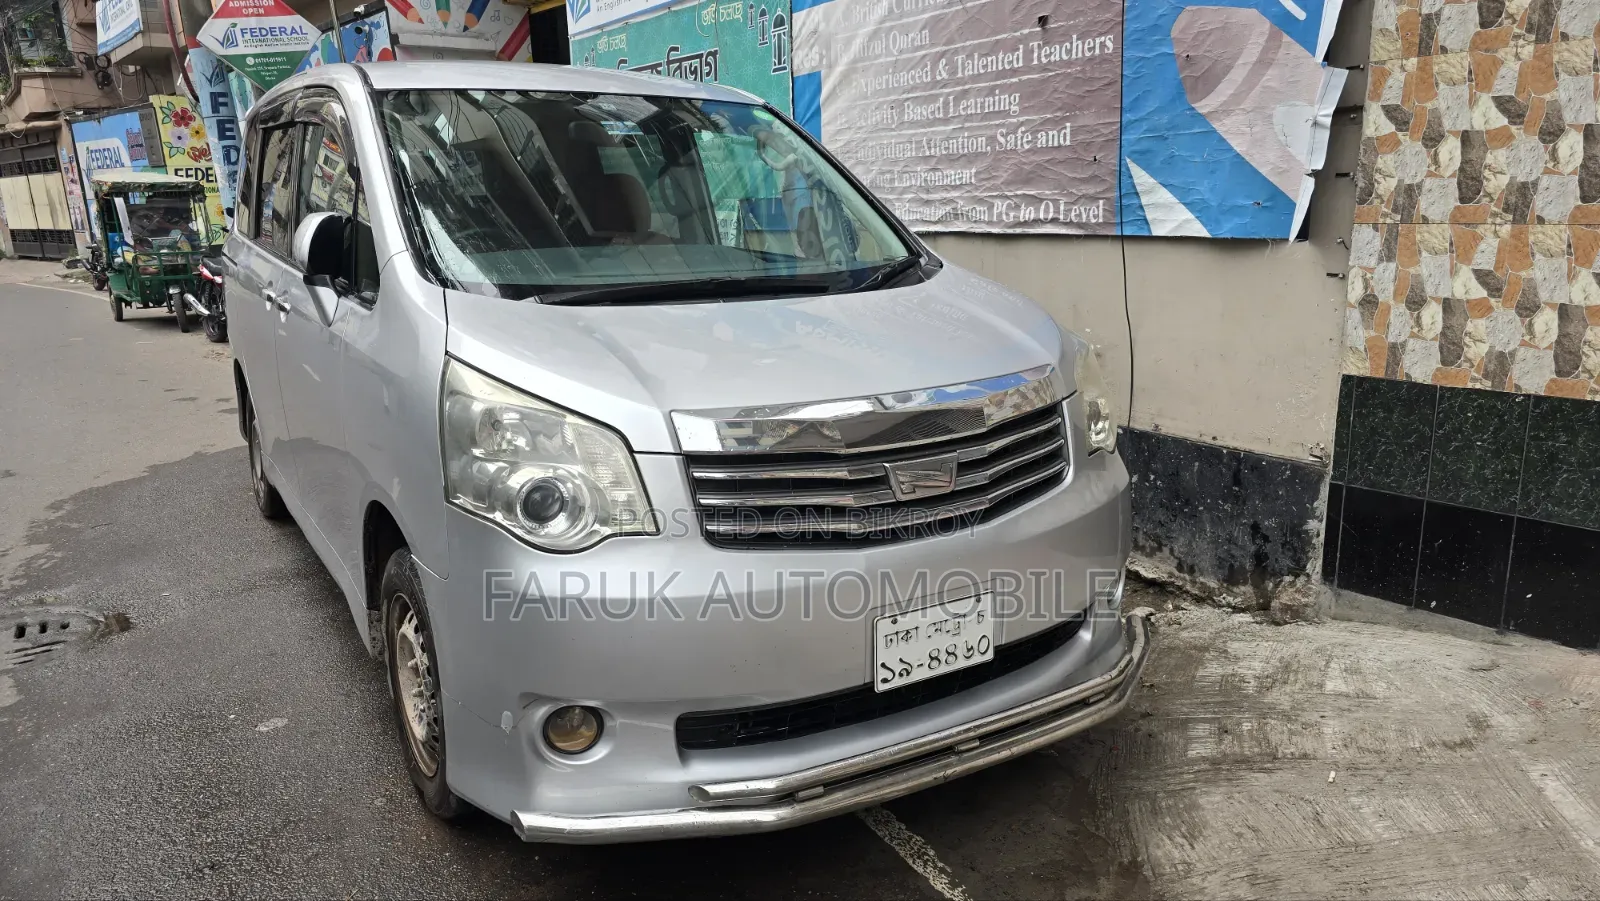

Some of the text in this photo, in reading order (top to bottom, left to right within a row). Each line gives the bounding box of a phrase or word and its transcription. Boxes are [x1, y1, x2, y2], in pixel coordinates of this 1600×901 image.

[242, 7, 265, 15] OPEN
[240, 25, 309, 38] FEDERAL
[242, 35, 309, 45] INTERNATIONAL SCHOOL
[889, 28, 930, 55] Quran
[936, 58, 950, 81] &
[954, 44, 1024, 80] Talented
[1029, 34, 1115, 66] Teachers
[903, 97, 943, 122] Based
[947, 90, 1021, 118] Learning
[919, 132, 991, 157] Attention,
[995, 126, 1032, 151] Safe
[1037, 123, 1071, 147] and
[90, 146, 126, 169] FEDERAL
[893, 165, 977, 188] Environment
[956, 200, 989, 222] from
[993, 199, 1016, 223] PG
[1019, 202, 1035, 220] to
[1039, 200, 1054, 222] O
[1059, 199, 1104, 223] Level
[883, 626, 919, 649] ঢাকা
